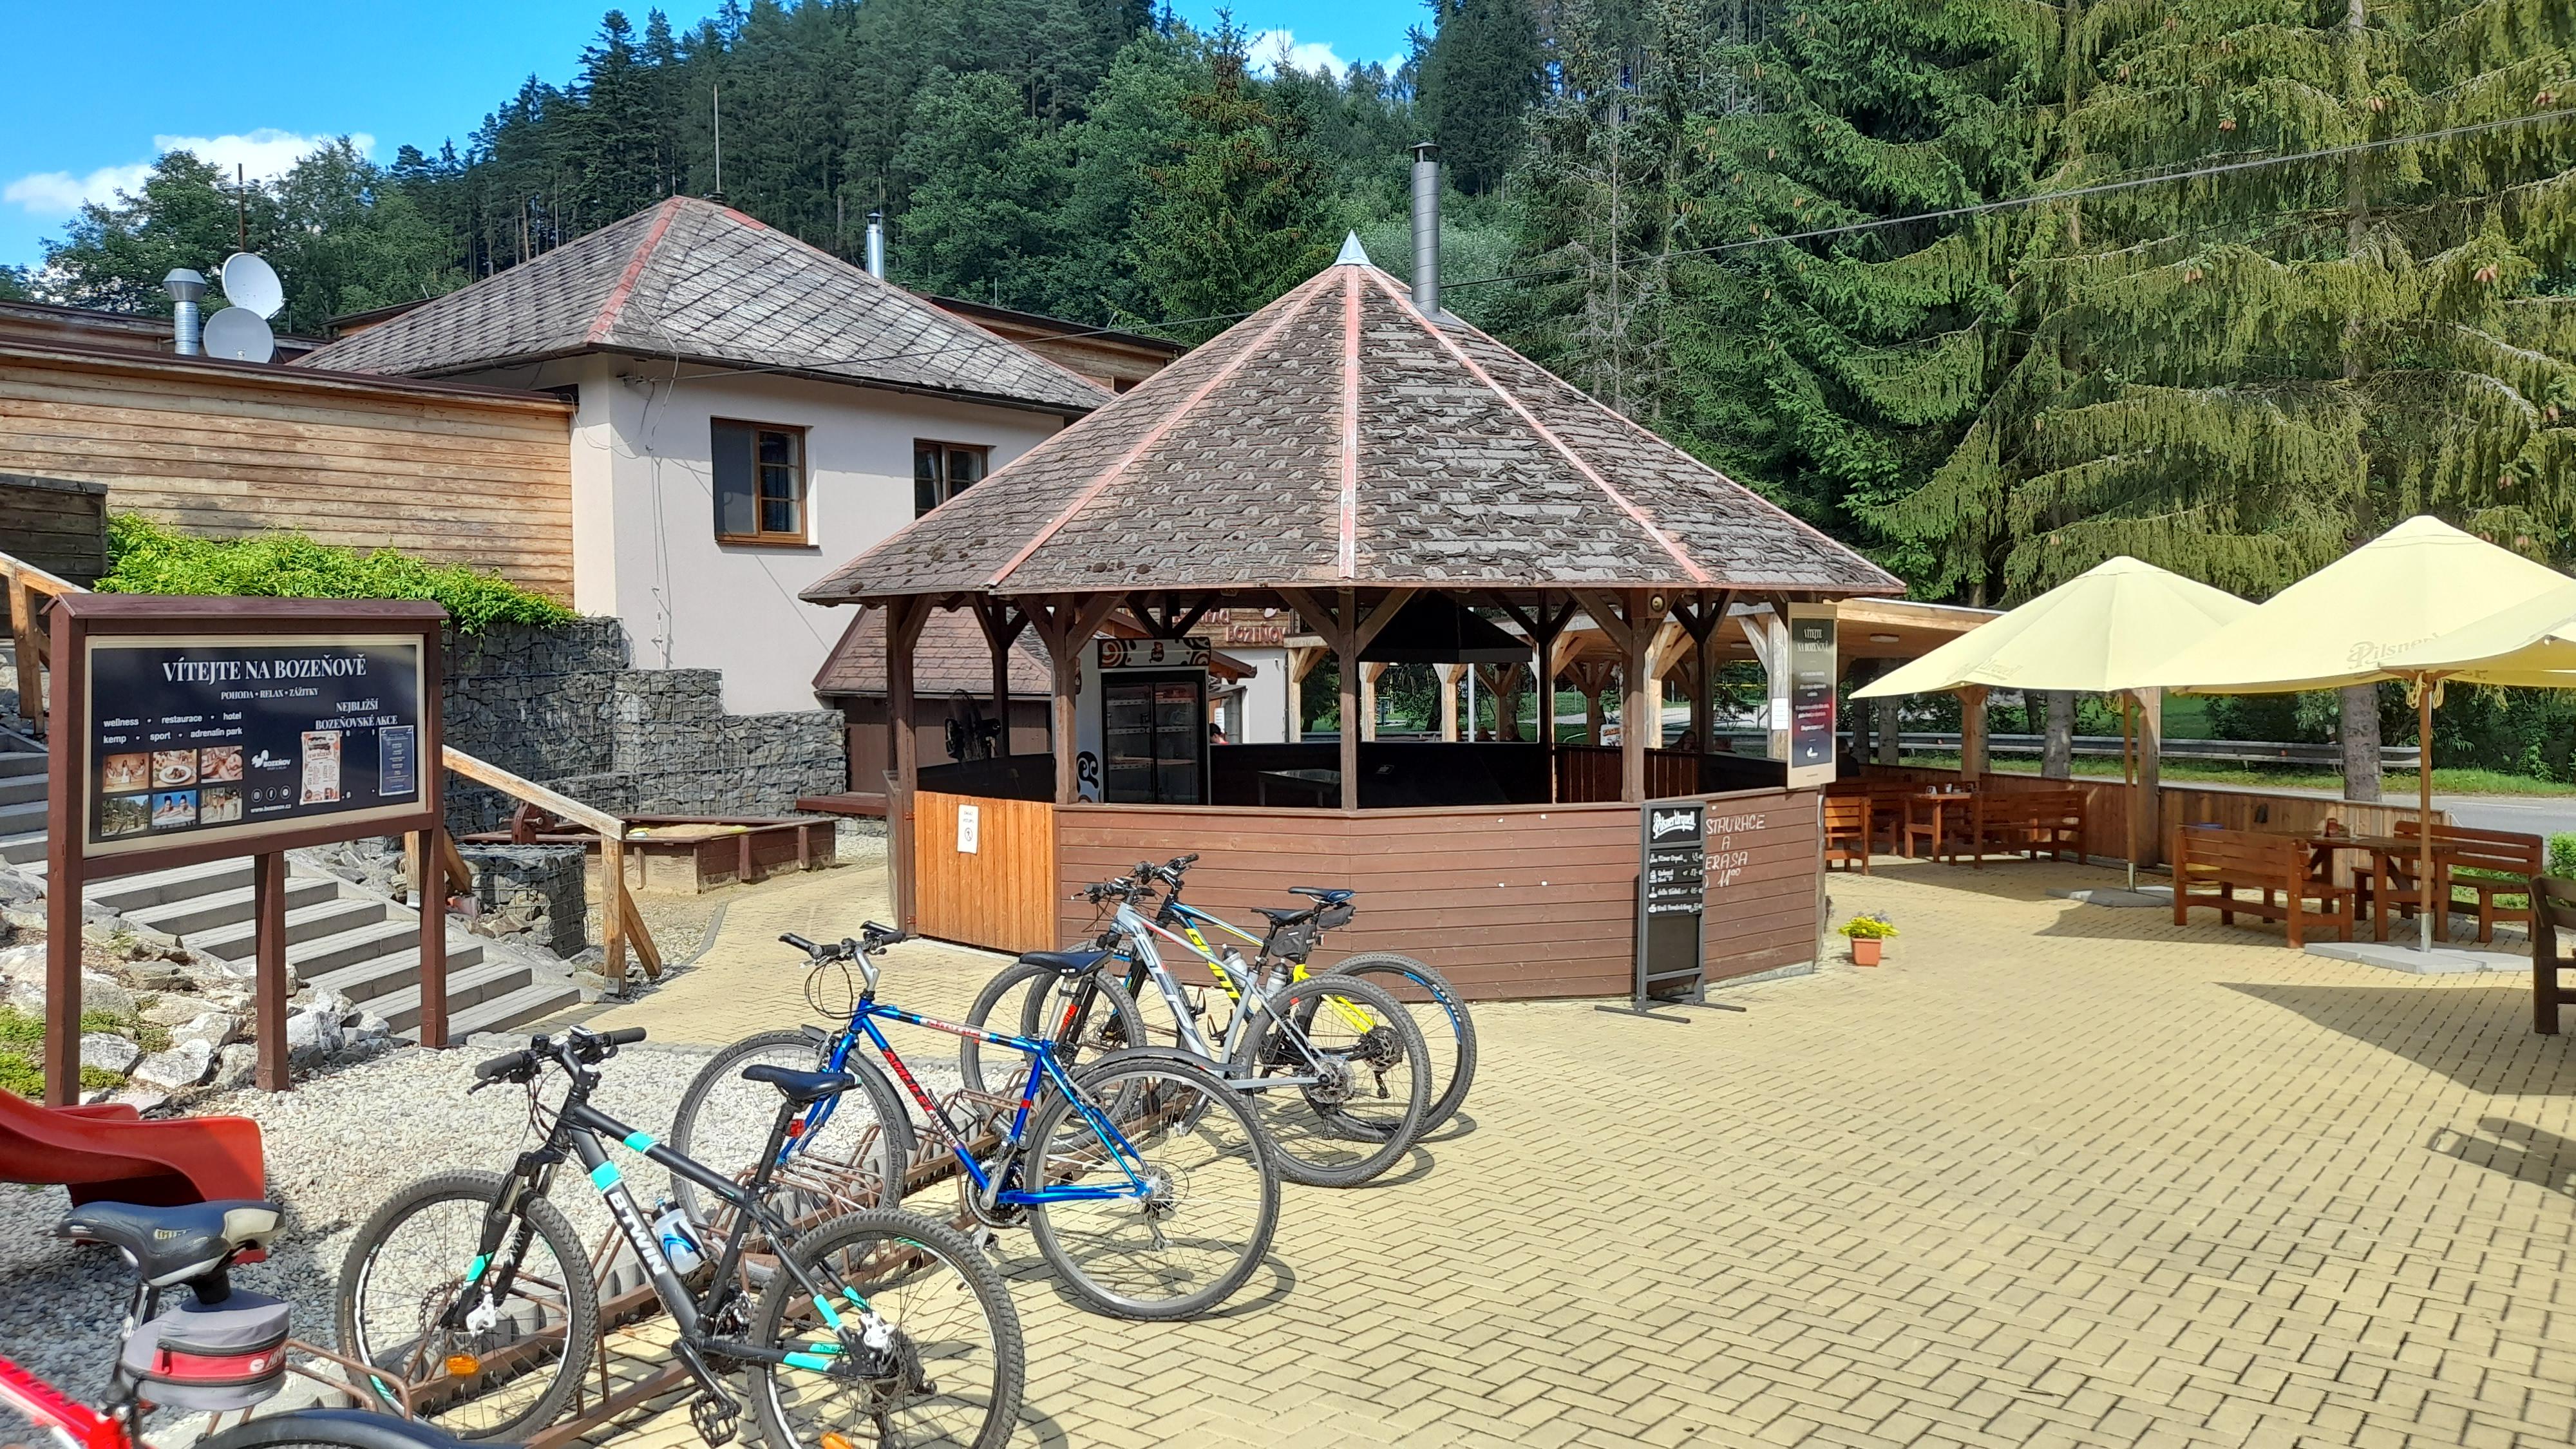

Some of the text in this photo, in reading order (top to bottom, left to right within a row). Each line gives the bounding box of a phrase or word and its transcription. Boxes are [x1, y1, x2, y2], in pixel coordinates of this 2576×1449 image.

[2346, 638, 2431, 669] Pilsn
[162, 653, 367, 685] VÍTEJTE NA BOZEŇOVĚ
[221, 687, 319, 700] POHODA RELAX ZÁŽITKY
[336, 698, 379, 714] NEJBLIŽŠÍ
[103, 712, 242, 728] wellness restaurace hotel
[315, 714, 398, 730] BOZEŇOVSKÉ AKCE
[103, 727, 243, 744] kemp sport adrenalin park
[1653, 810, 1697, 840] Pilsner Urquell
[1721, 836, 1730, 851] A
[883, 1050, 958, 1147] AMULET active
